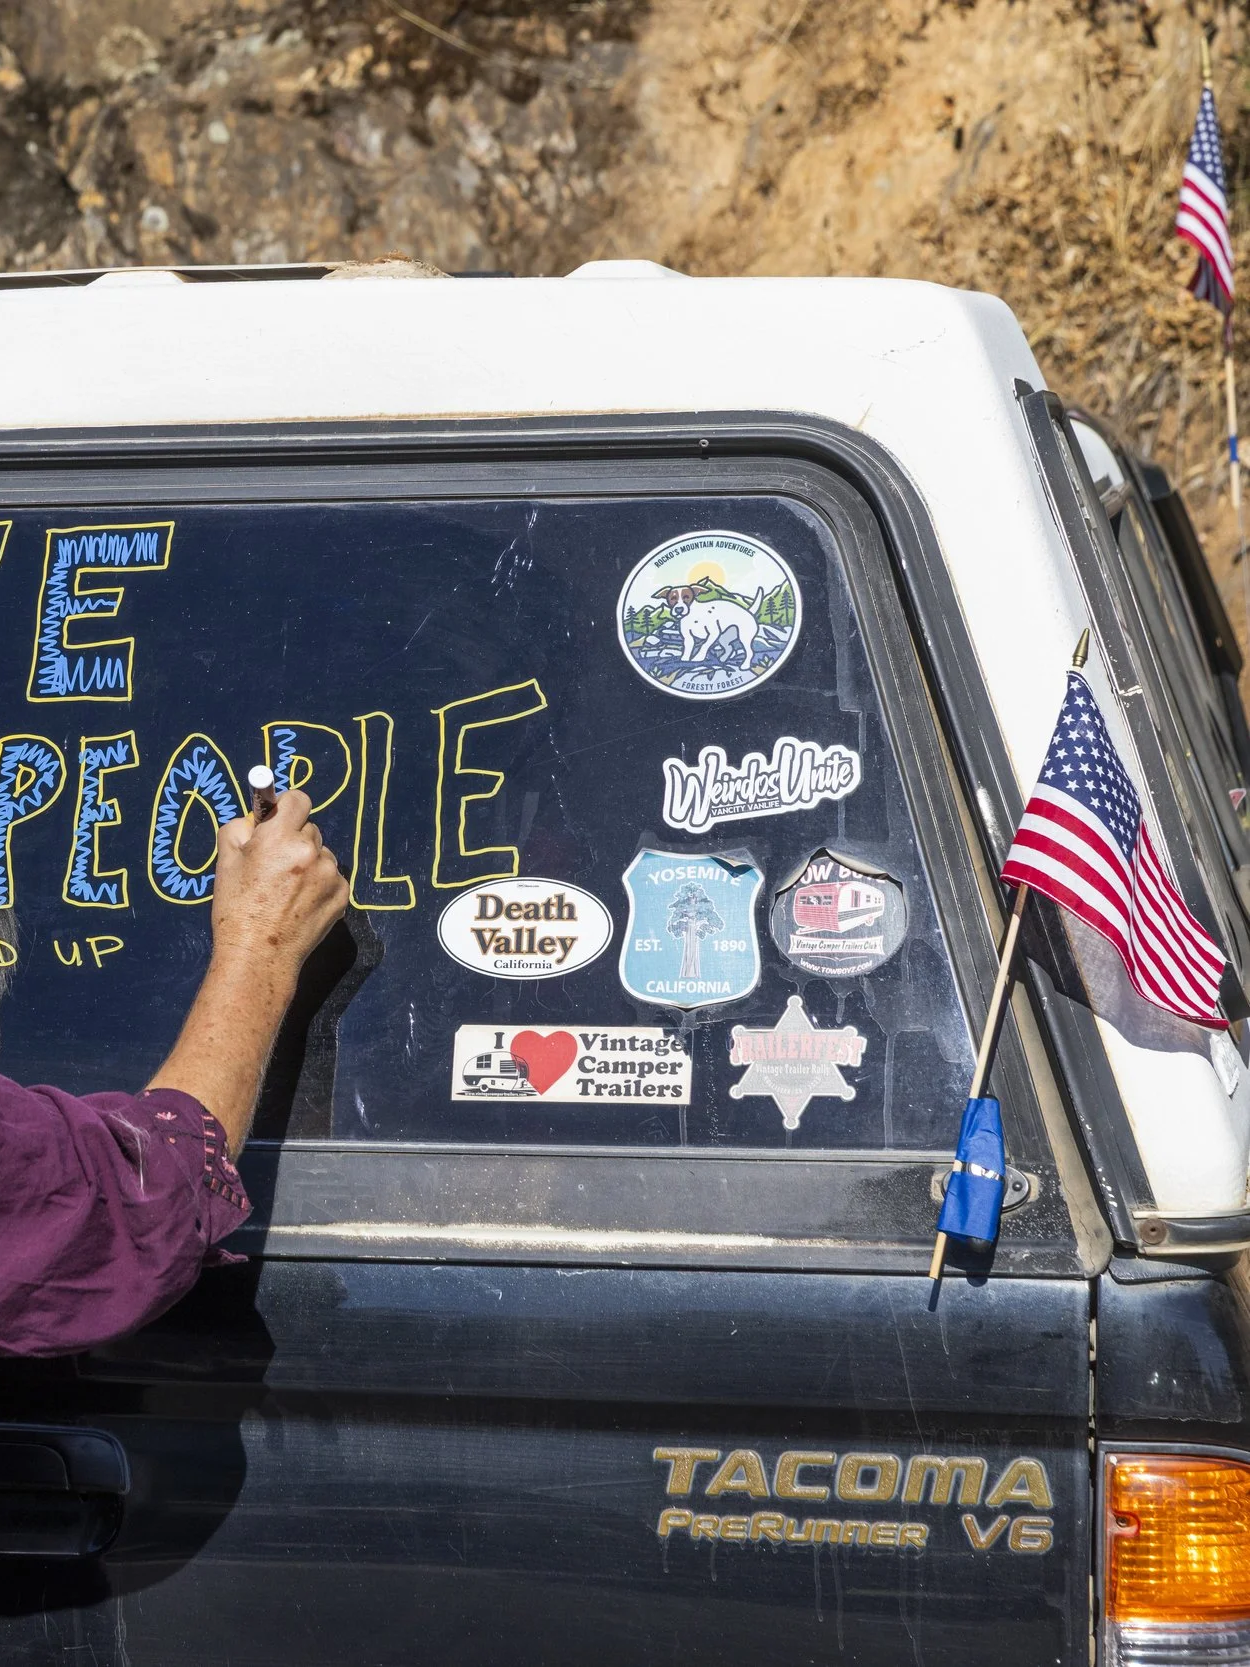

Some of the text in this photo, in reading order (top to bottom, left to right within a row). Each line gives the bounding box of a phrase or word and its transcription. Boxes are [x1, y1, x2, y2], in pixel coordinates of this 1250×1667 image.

[654, 541, 756, 569] ROCKO'S MOUNTAIN ADVENTURES
[681, 676, 744, 691] FORESTY FOREST
[669, 743, 854, 826] Weirdos Unite
[711, 801, 780, 817] VANCITY VANLIFE
[647, 865, 742, 887] YOSEMITE
[795, 862, 834, 888] OW
[474, 892, 578, 921] Death
[53, 935, 124, 968] UP
[470, 926, 578, 965] Valley
[635, 939, 746, 952] EST. 1890
[796, 940, 877, 950] Vintage Camper Trailers Club
[493, 959, 552, 969] California
[800, 957, 872, 975] WWW.TOWBOYZ.COM
[646, 980, 732, 993] CALIFORNIA
[494, 1031, 688, 1056] I Vintage
[577, 1056, 683, 1078] Camper
[784, 1063, 810, 1074] Trailer
[576, 1078, 683, 1098] Trailers
[652, 1447, 1053, 1509] TACOMA
[962, 1514, 1054, 1553] V6
